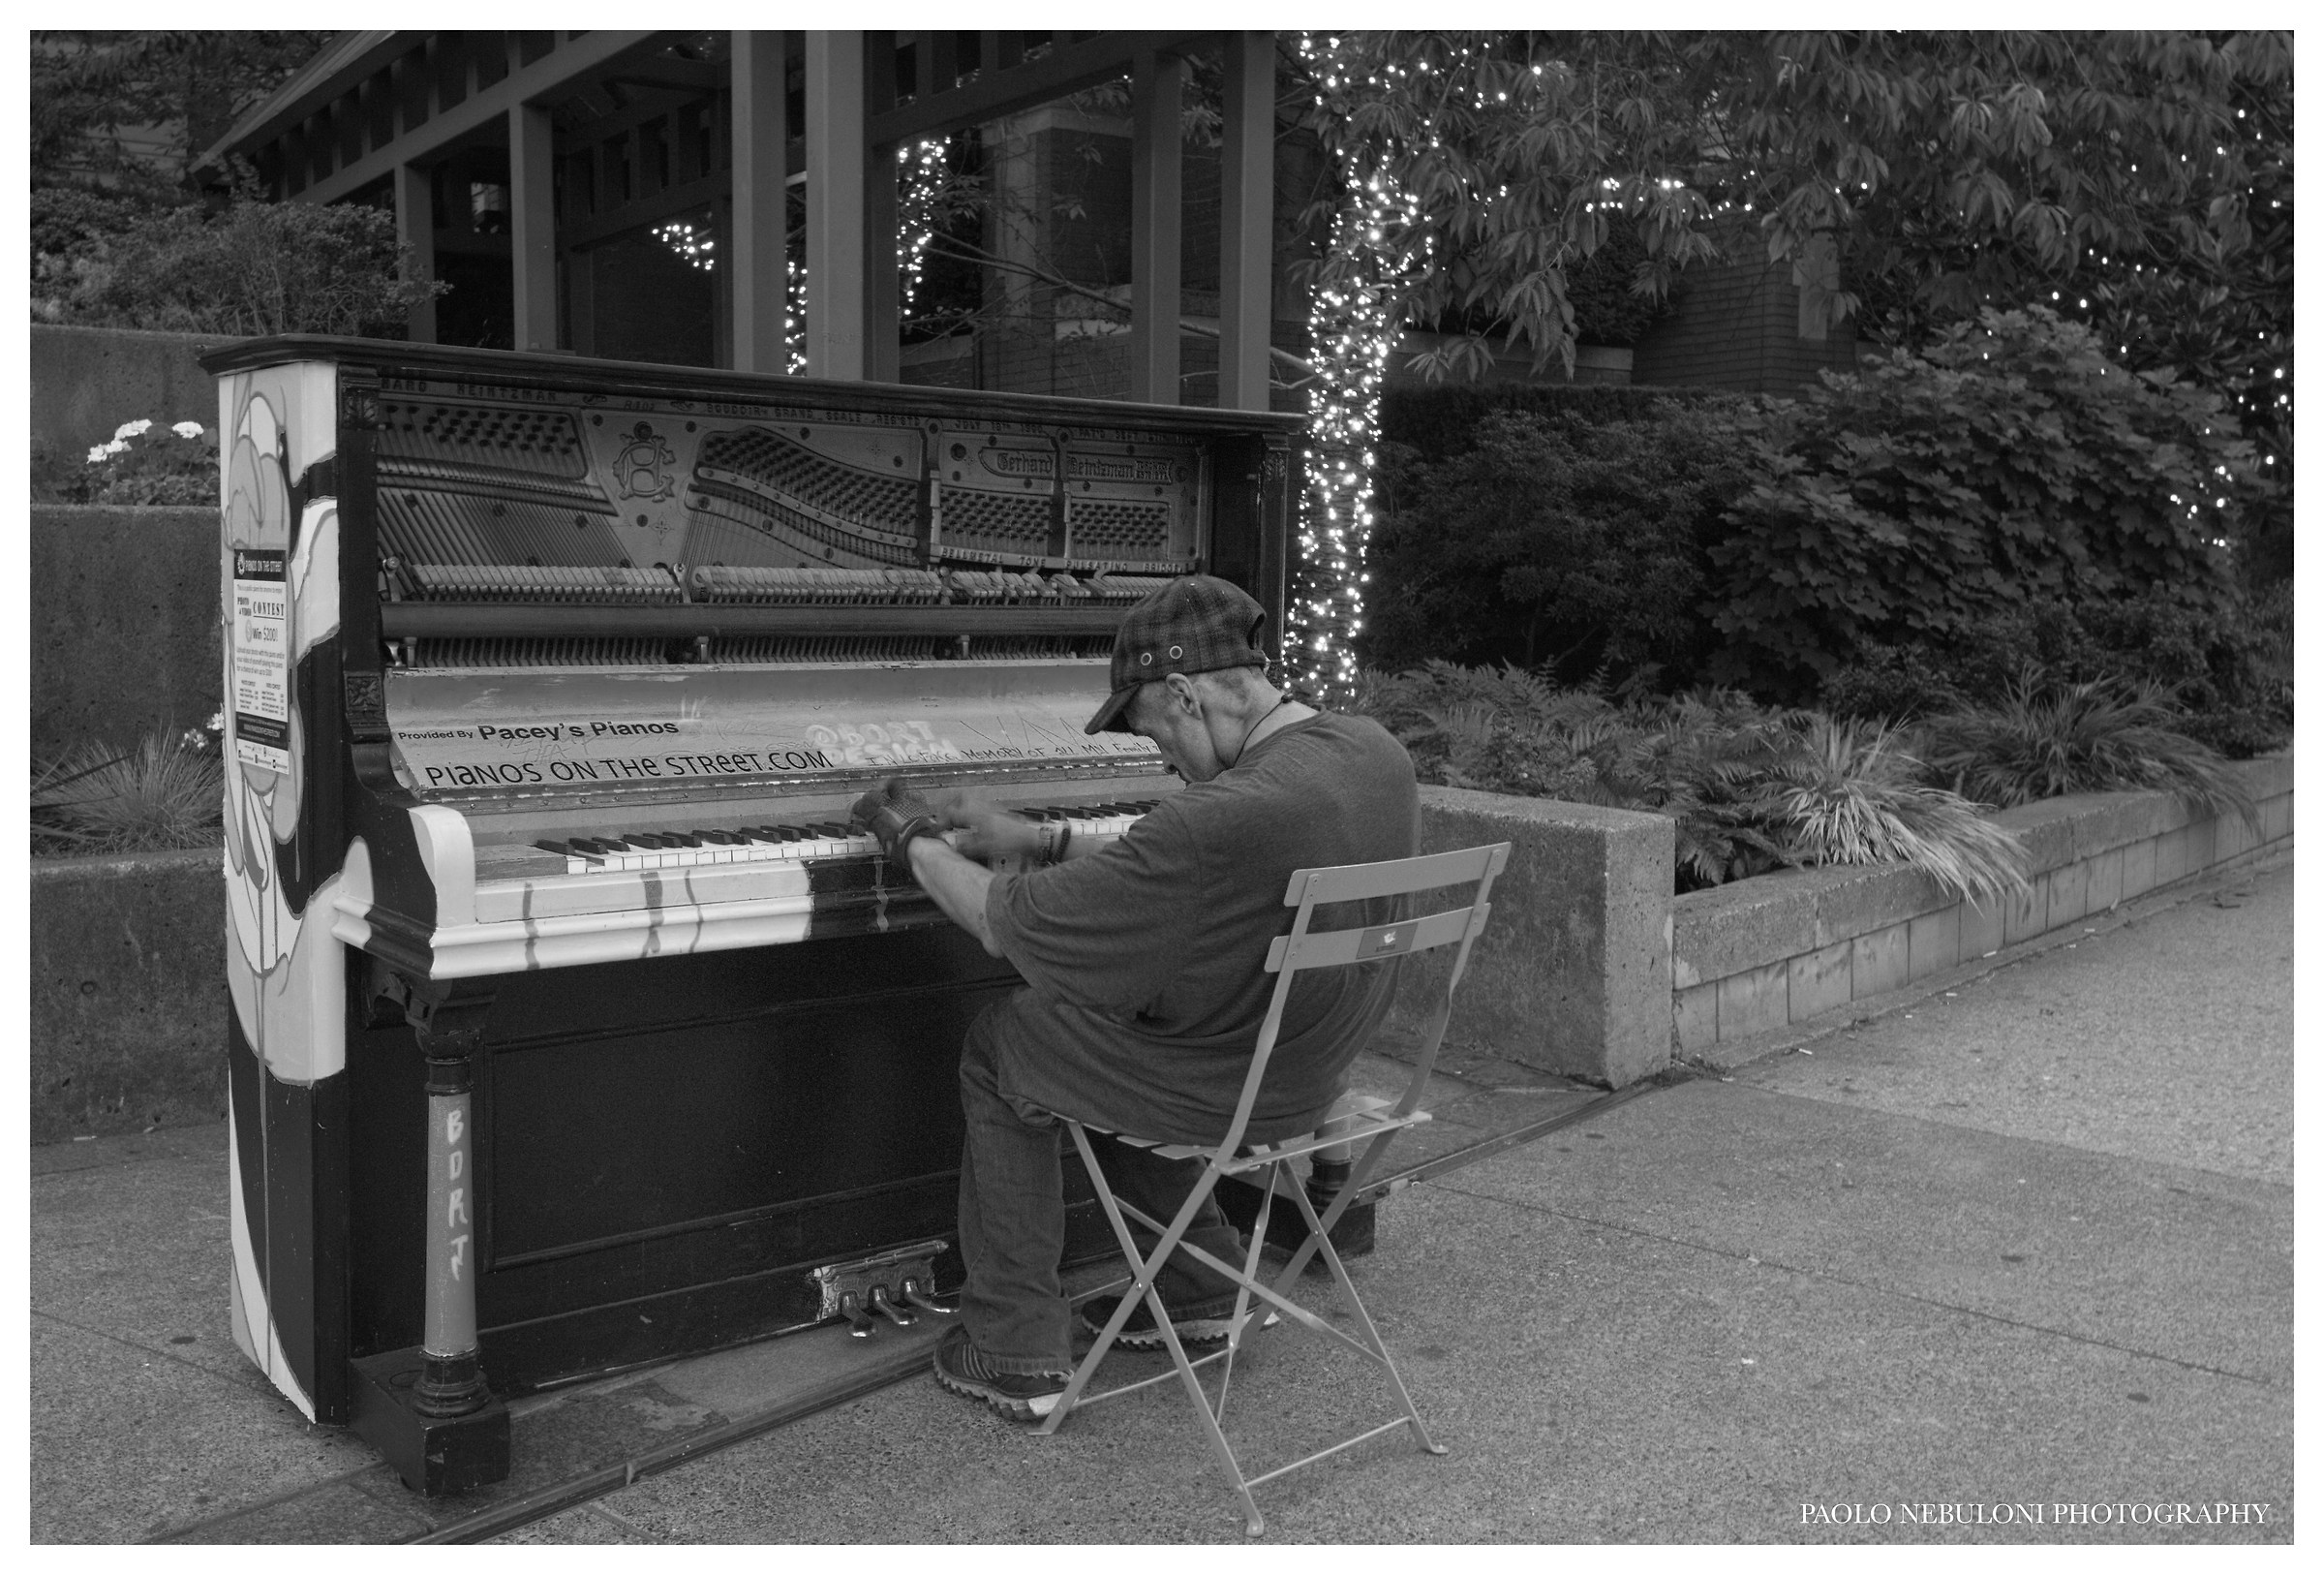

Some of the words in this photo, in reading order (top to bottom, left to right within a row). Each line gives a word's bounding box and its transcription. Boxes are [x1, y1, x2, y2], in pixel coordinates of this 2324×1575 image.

[997, 451, 1054, 474] Gerhard
[941, 546, 1004, 564] BELLMETAL
[1019, 555, 1047, 568] TONE
[1065, 559, 1128, 572] PULSATING
[253, 601, 285, 617] CONTEST
[398, 731, 454, 740] Provided
[456, 729, 474, 739] By
[477, 722, 585, 742] Pacey's
[589, 721, 680, 736] Pianos
[549, 759, 598, 781] ON
